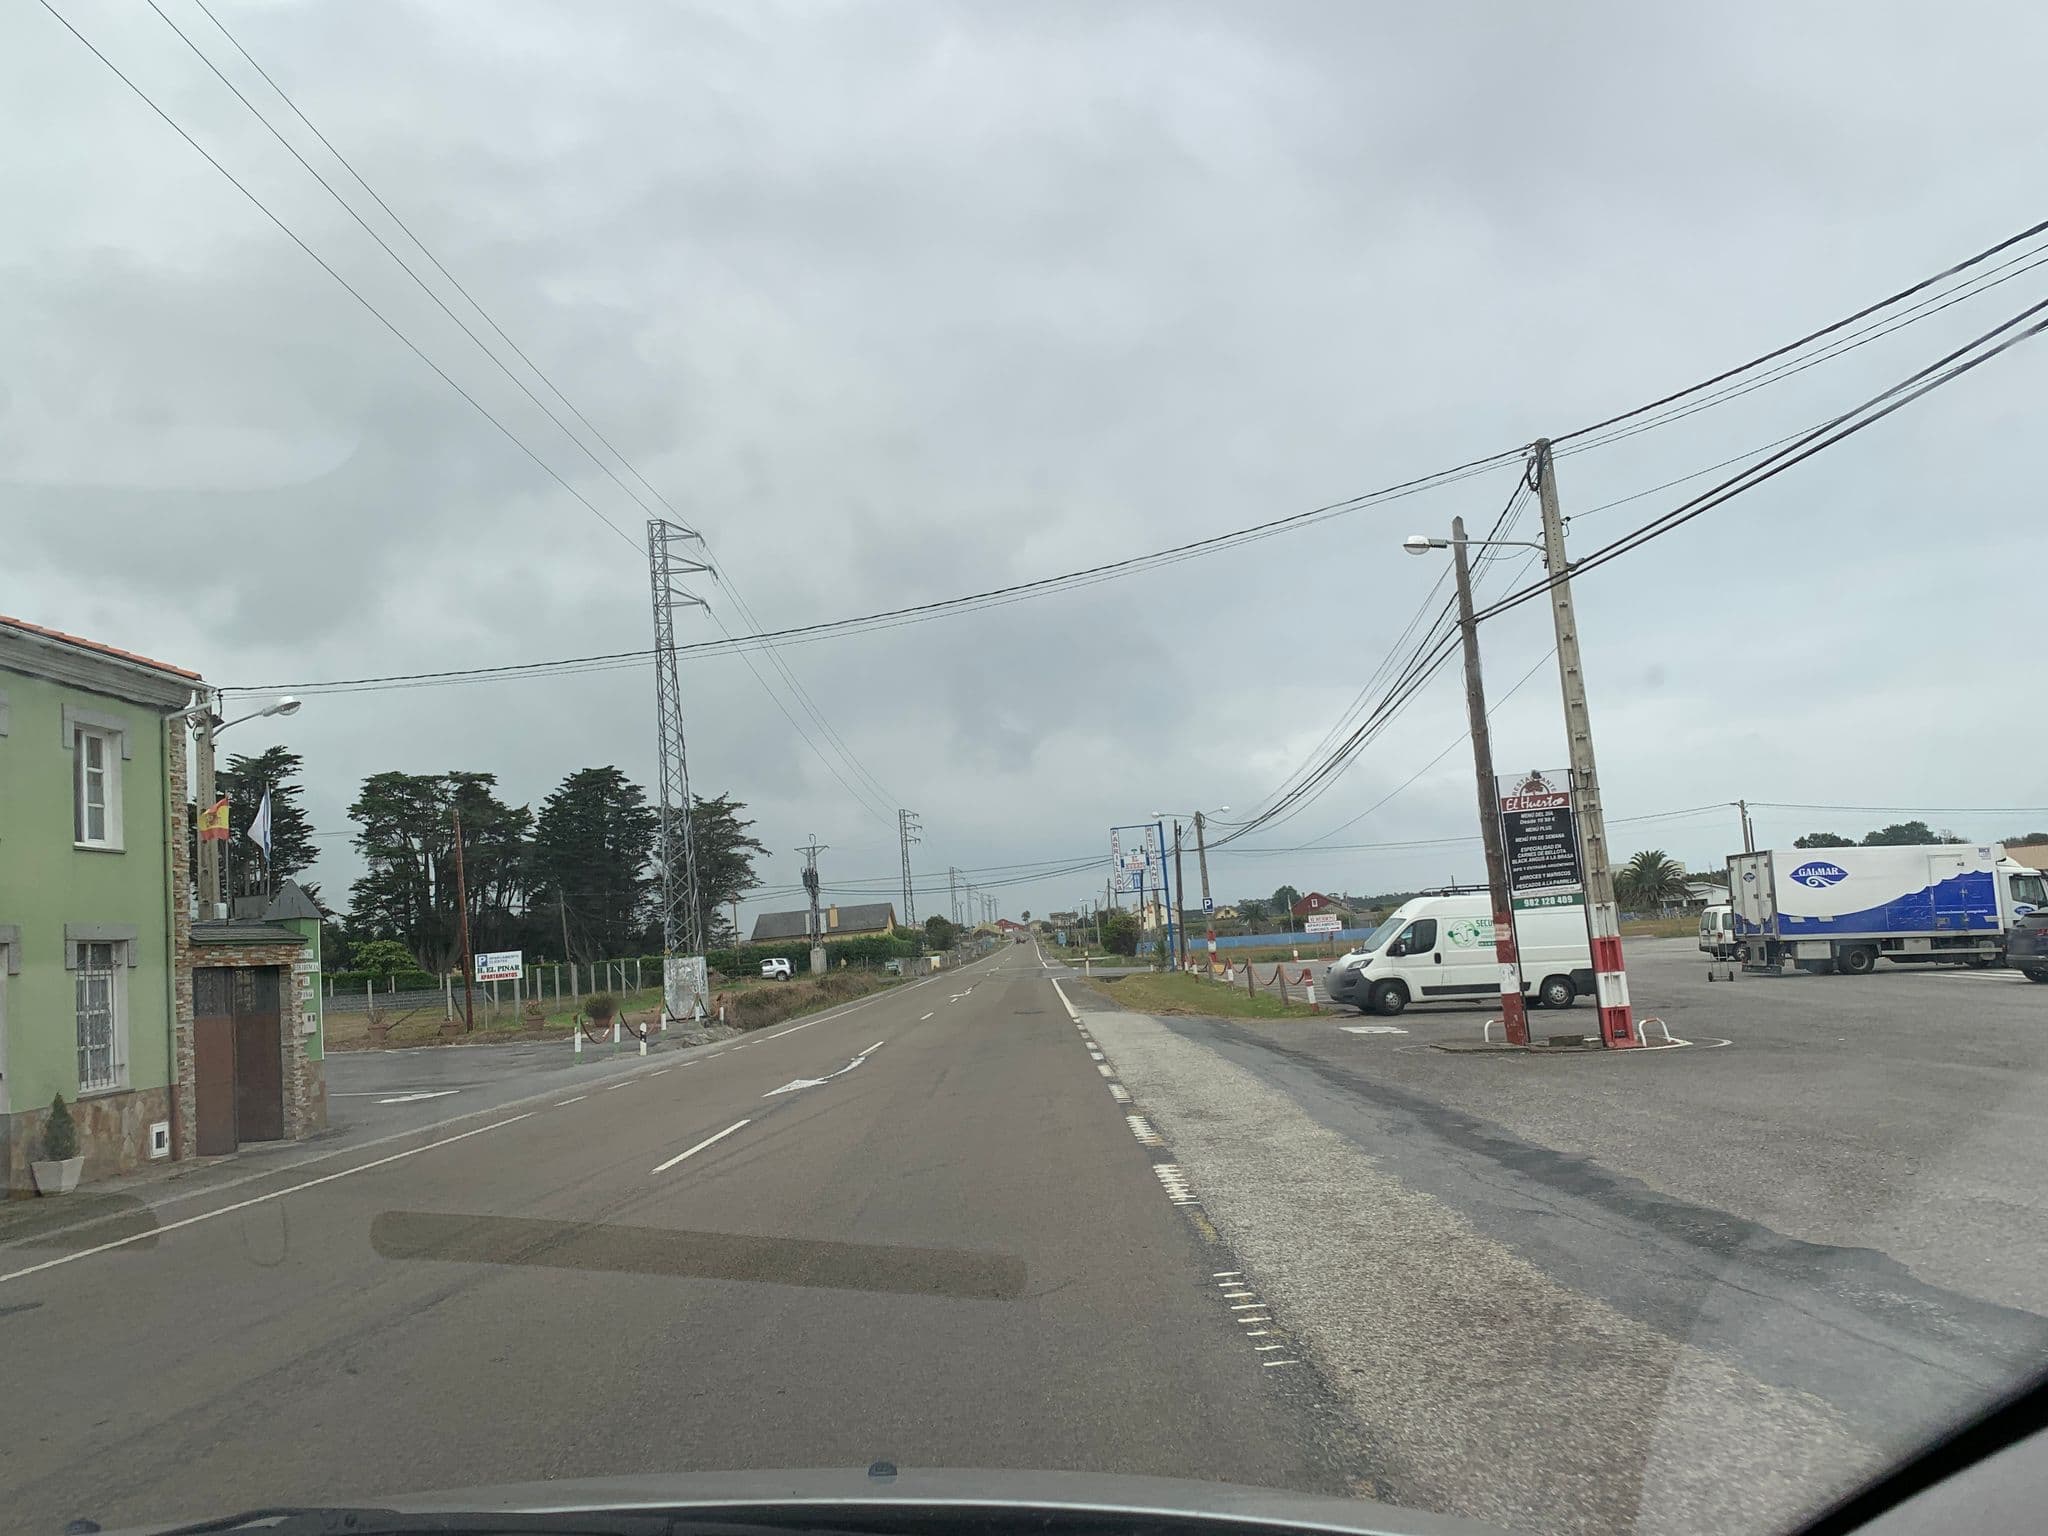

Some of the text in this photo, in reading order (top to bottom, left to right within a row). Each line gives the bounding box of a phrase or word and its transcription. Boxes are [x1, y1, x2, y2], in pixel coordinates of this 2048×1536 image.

[1512, 775, 1557, 796] RESTAANTE
[1506, 795, 1564, 810] El Huerto
[1520, 844, 1554, 852] ESPECIALIDAD
[1799, 867, 1839, 876] GALMAR
[1476, 919, 1493, 927] SECU
[497, 964, 520, 972] PINAR
